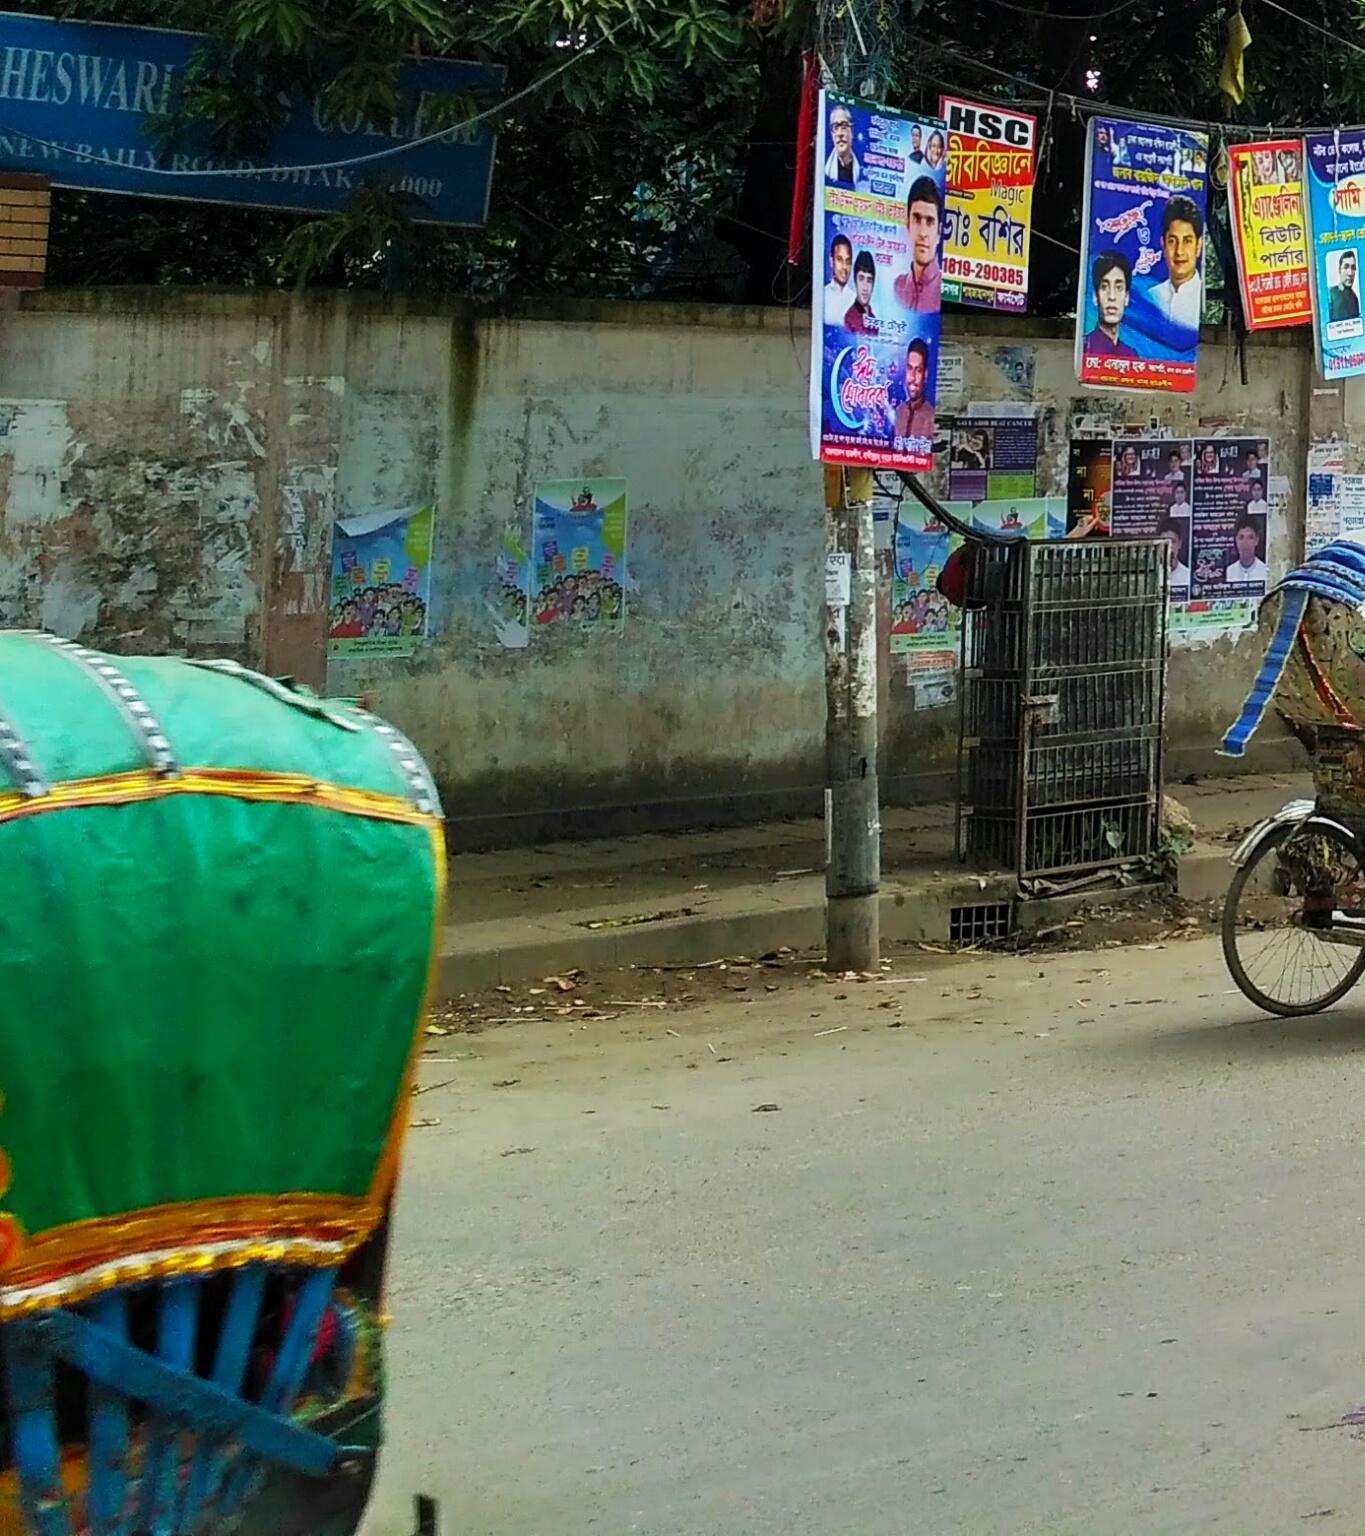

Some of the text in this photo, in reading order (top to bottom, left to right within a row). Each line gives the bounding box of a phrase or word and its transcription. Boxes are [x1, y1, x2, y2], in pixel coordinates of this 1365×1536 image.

[950, 105, 1029, 146] HSC
[990, 177, 1025, 206] Magic
[977, 205, 1027, 259] বশির
[1259, 223, 1302, 246] বিউটি
[1259, 246, 1304, 269] পার্লার
